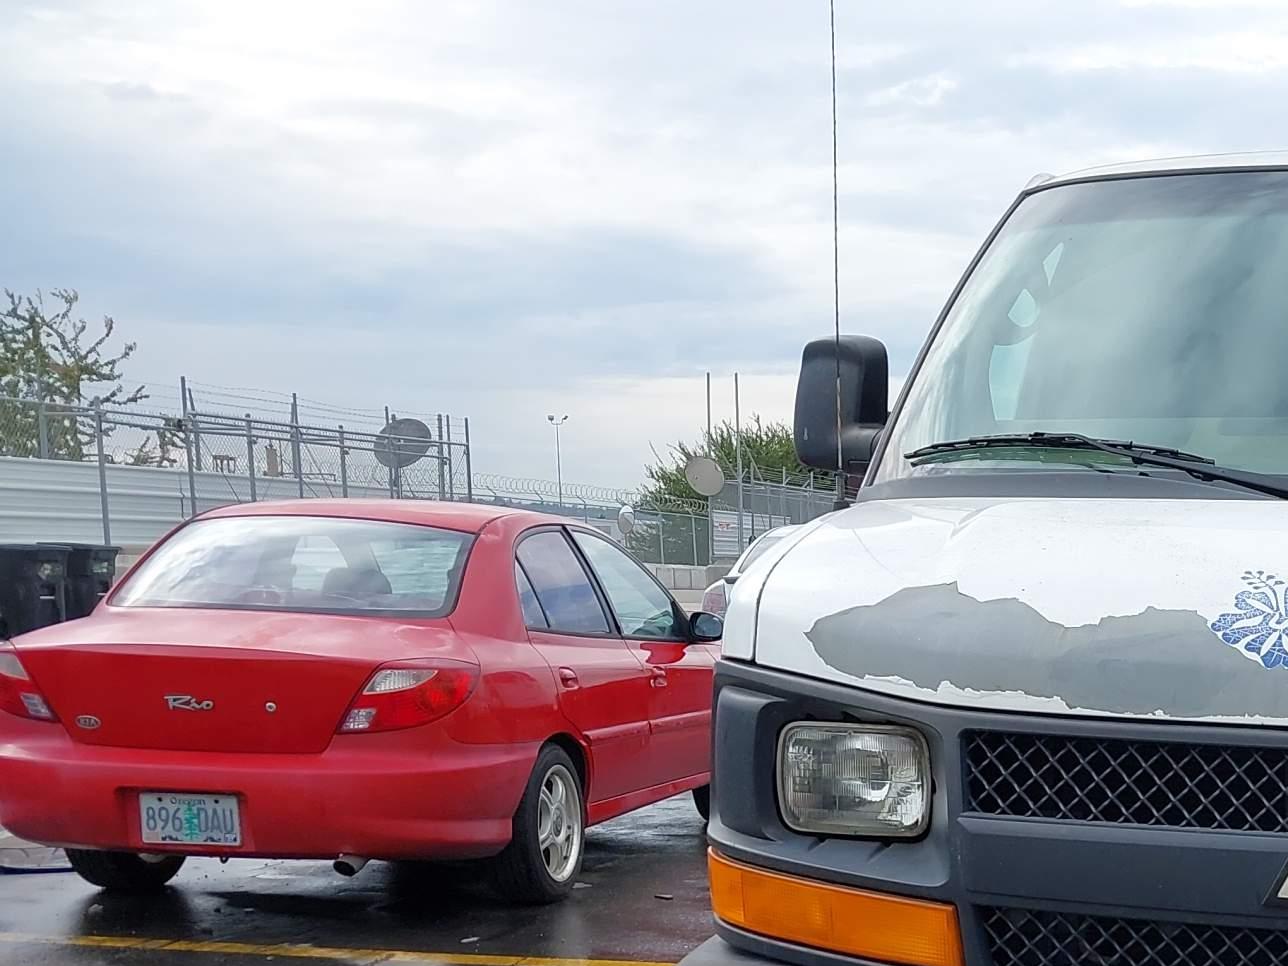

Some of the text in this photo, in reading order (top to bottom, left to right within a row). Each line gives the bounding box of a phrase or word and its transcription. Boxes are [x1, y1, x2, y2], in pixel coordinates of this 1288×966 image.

[164, 695, 213, 711] Rio
[146, 806, 234, 833] 896 DAU
